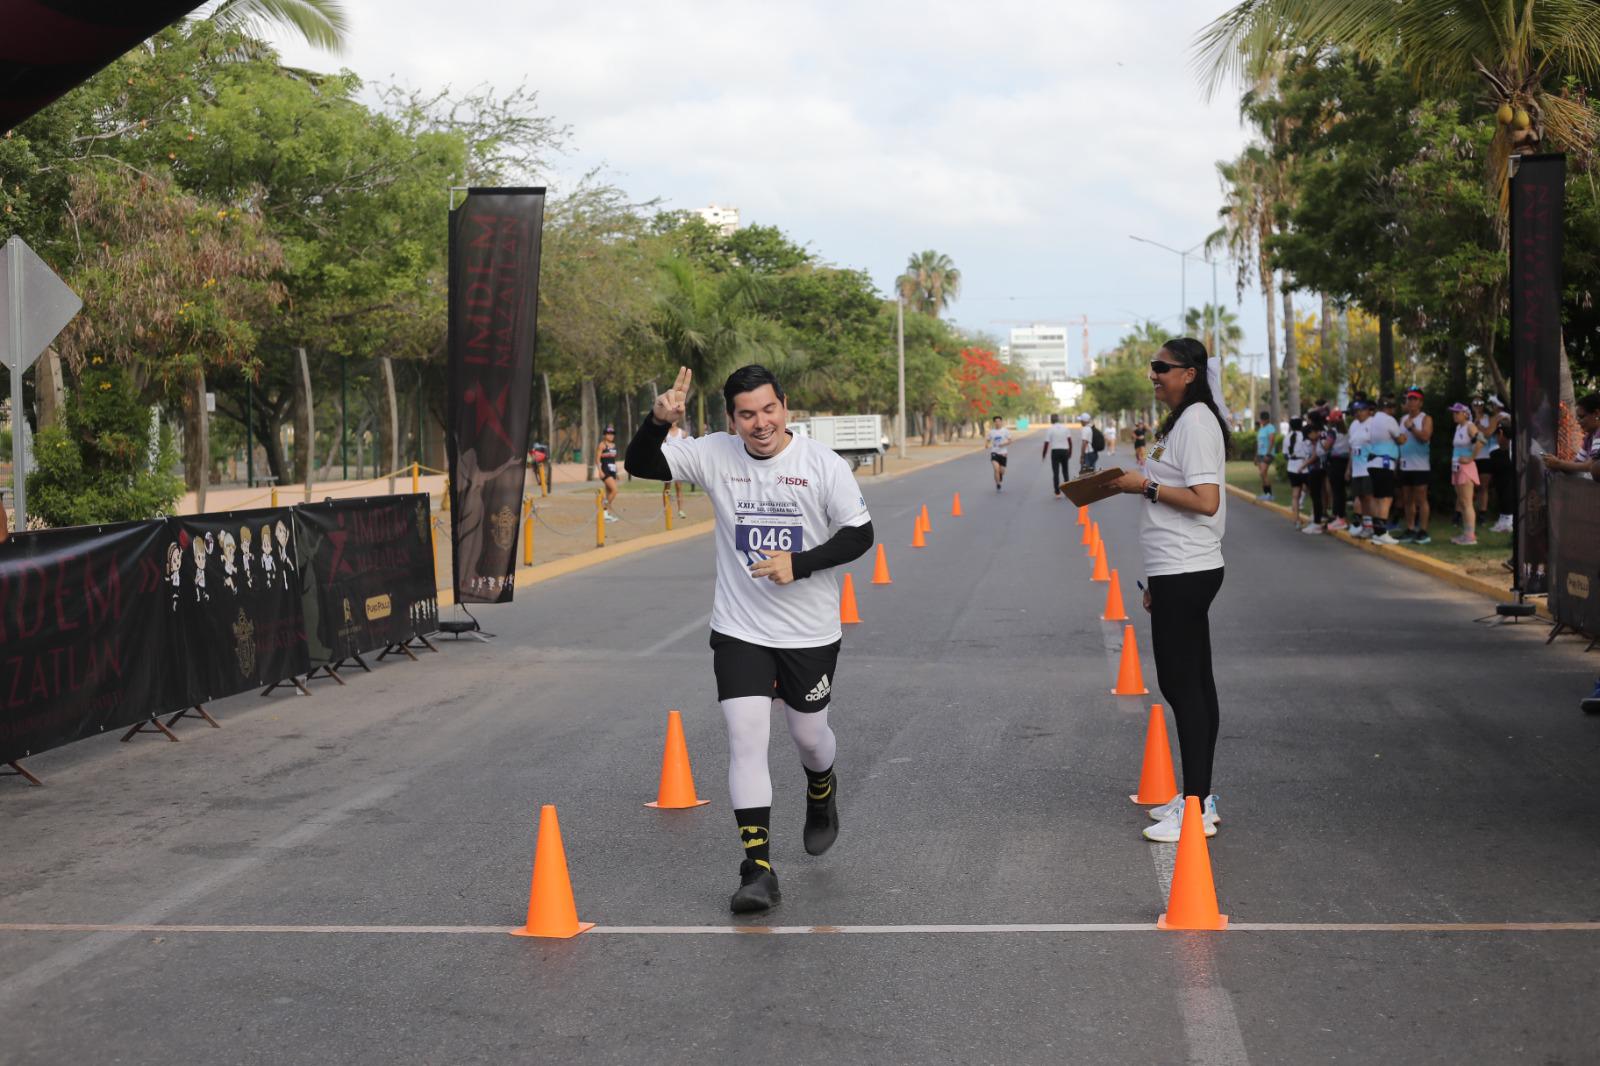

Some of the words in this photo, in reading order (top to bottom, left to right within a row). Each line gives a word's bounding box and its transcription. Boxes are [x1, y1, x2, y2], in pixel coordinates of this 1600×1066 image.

[464, 214, 497, 366] IMDEM
[785, 477, 808, 488] ISDE
[737, 502, 755, 510] XXIX
[748, 527, 793, 551] 046
[0, 638, 124, 709] ZATLAN
